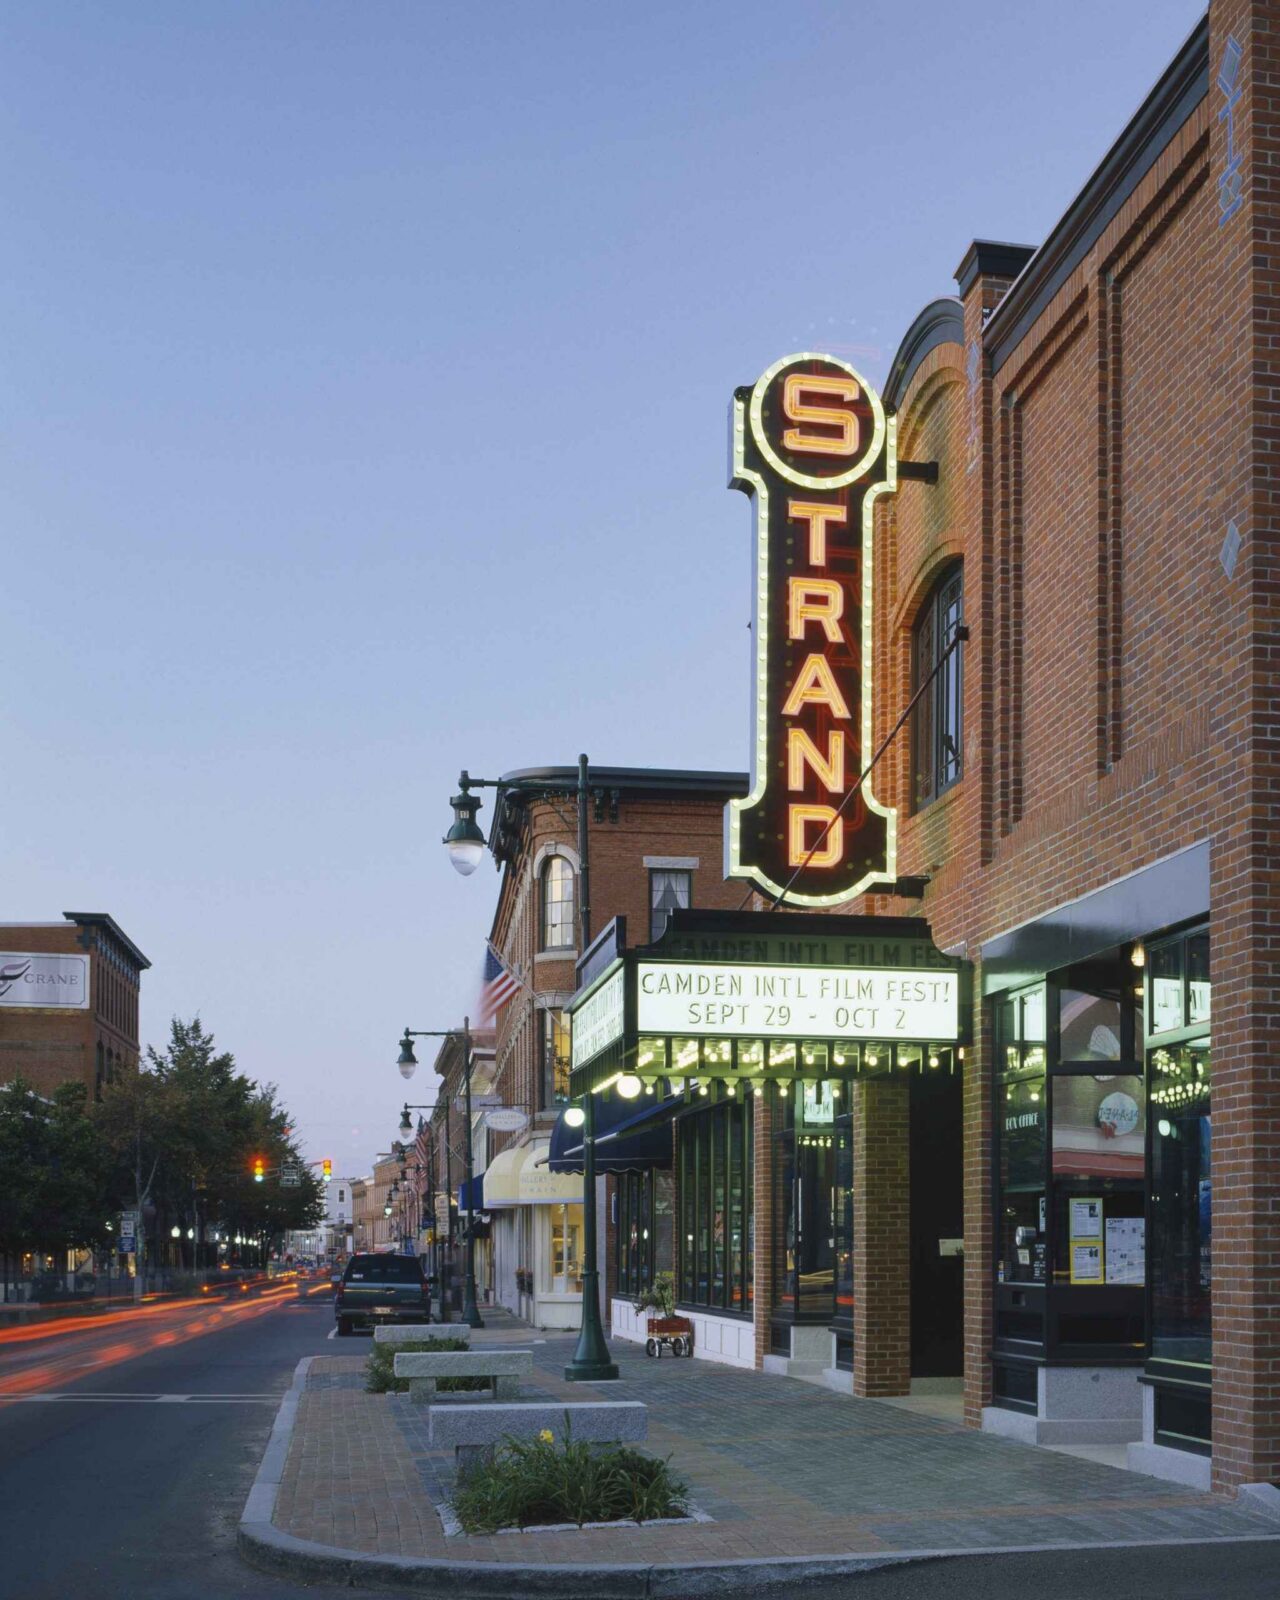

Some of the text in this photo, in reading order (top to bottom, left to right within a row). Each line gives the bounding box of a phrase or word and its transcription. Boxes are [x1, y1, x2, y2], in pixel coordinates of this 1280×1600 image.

[782, 373, 859, 868] STRAND
[24, 973, 78, 984] CRANE
[641, 972, 951, 1003] CAMDEN INTL FILM FEST!
[688, 1003, 751, 1025] SEPT
[764, 1005, 792, 1027] 29
[834, 1007, 880, 1028] OCT
[895, 1009, 906, 1029] 2
[1005, 1112, 1039, 1131] BOX OFFICE
